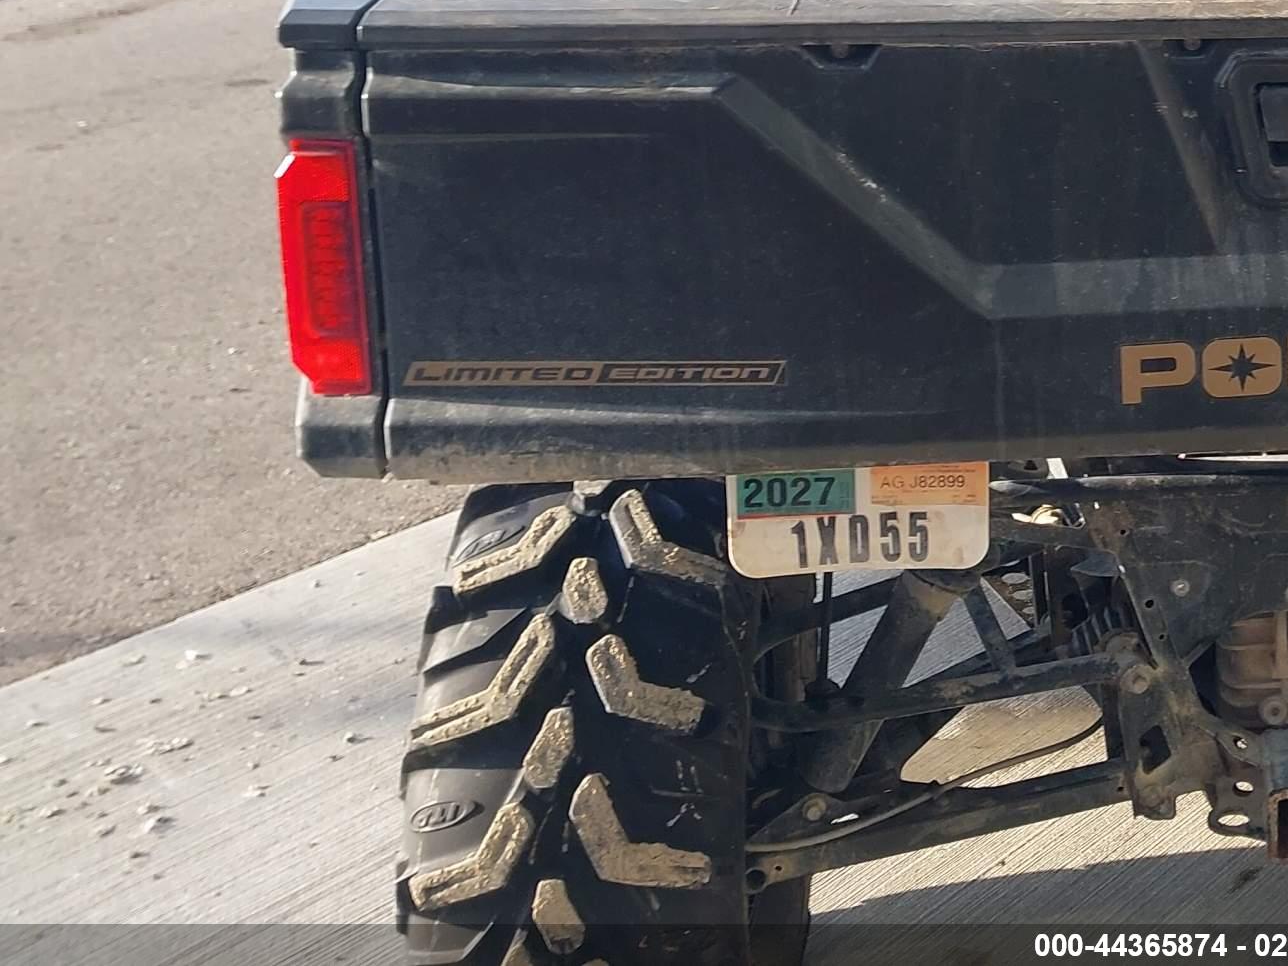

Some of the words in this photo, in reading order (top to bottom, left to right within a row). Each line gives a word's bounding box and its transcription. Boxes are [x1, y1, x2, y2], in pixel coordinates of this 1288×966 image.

[414, 367, 594, 381] LIMITED
[609, 368, 770, 380] EDITION
[880, 475, 905, 489] AG
[909, 474, 965, 488] J82899
[744, 477, 835, 508] 2027
